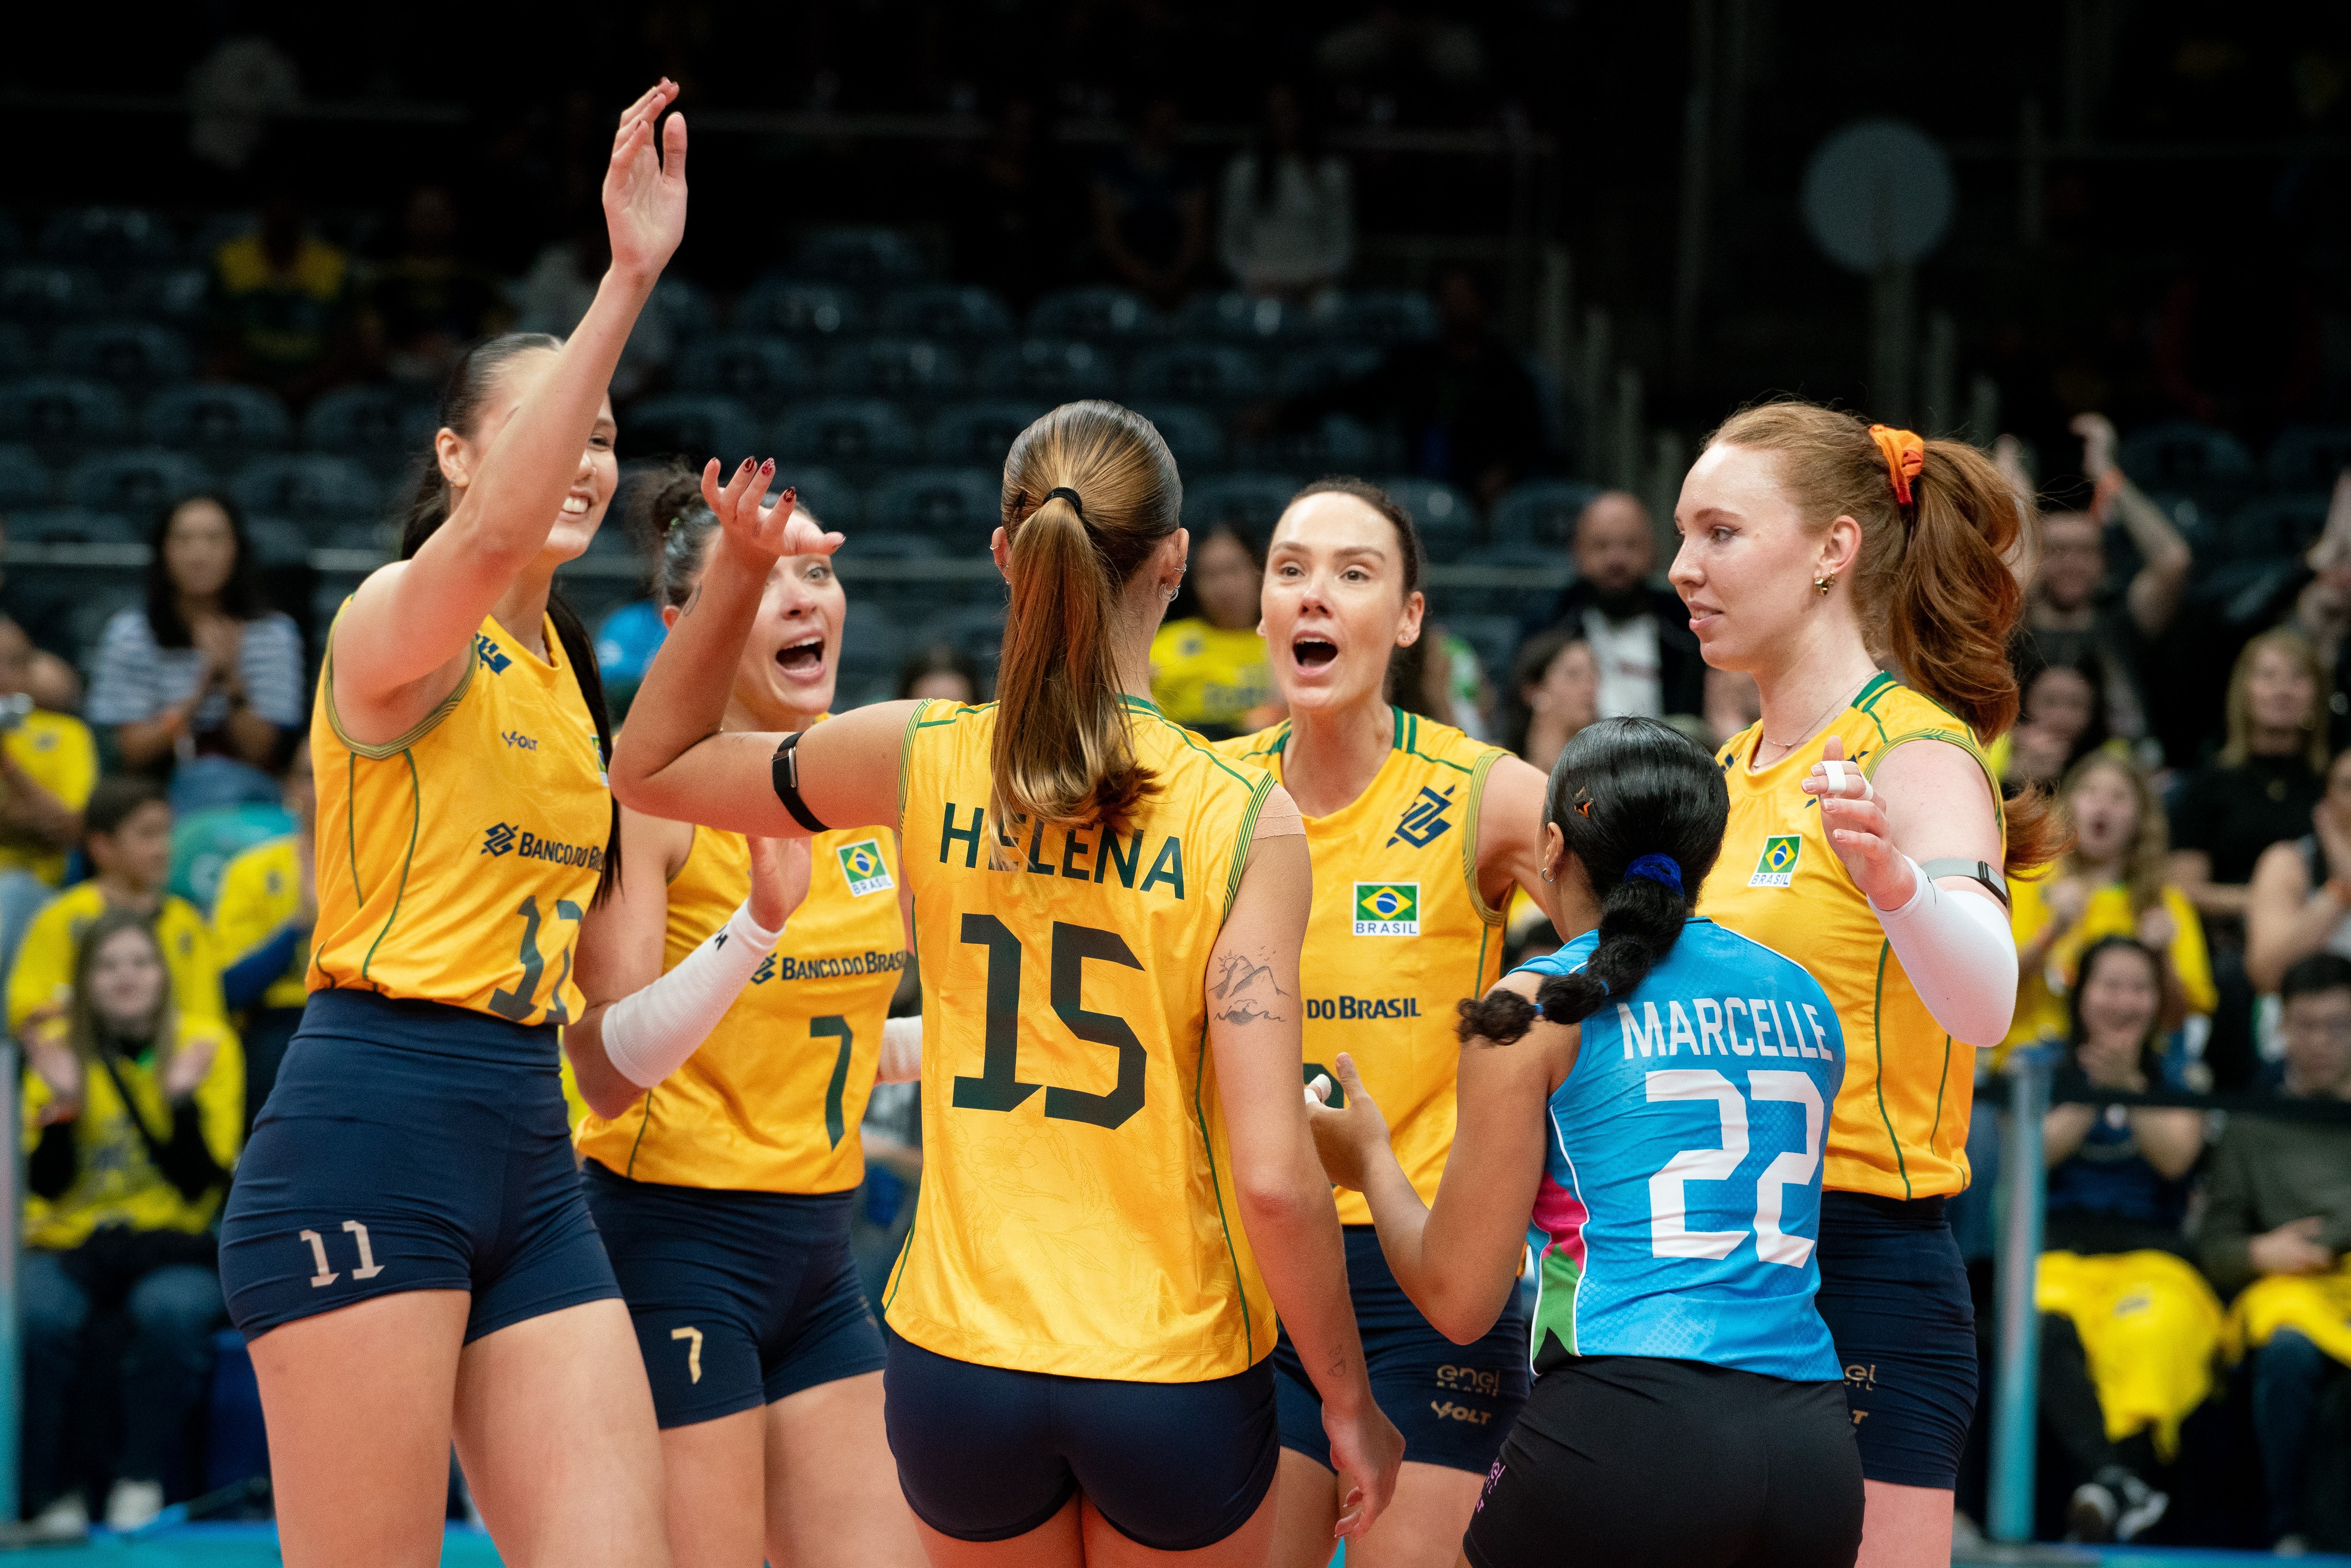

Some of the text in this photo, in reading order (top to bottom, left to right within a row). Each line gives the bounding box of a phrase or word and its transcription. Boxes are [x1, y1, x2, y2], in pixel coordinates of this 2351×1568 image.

[518, 832, 574, 865] BANCO
[1751, 875, 1789, 885] BRASIL
[1355, 923, 1417, 934] BRASIL
[782, 957, 841, 980] BANCO
[840, 956, 865, 976] DO
[952, 913, 1147, 1130] 15
[1307, 996, 1422, 1020] DO BRASIL
[1617, 997, 1833, 1061] MARCELLE
[809, 1015, 853, 1152] 7
[1645, 1069, 1824, 1268] 22
[299, 1220, 386, 1288] 11
[671, 1326, 703, 1385] 7
[1437, 1364, 1500, 1392] enel
[1431, 1400, 1492, 1425] VOLT
